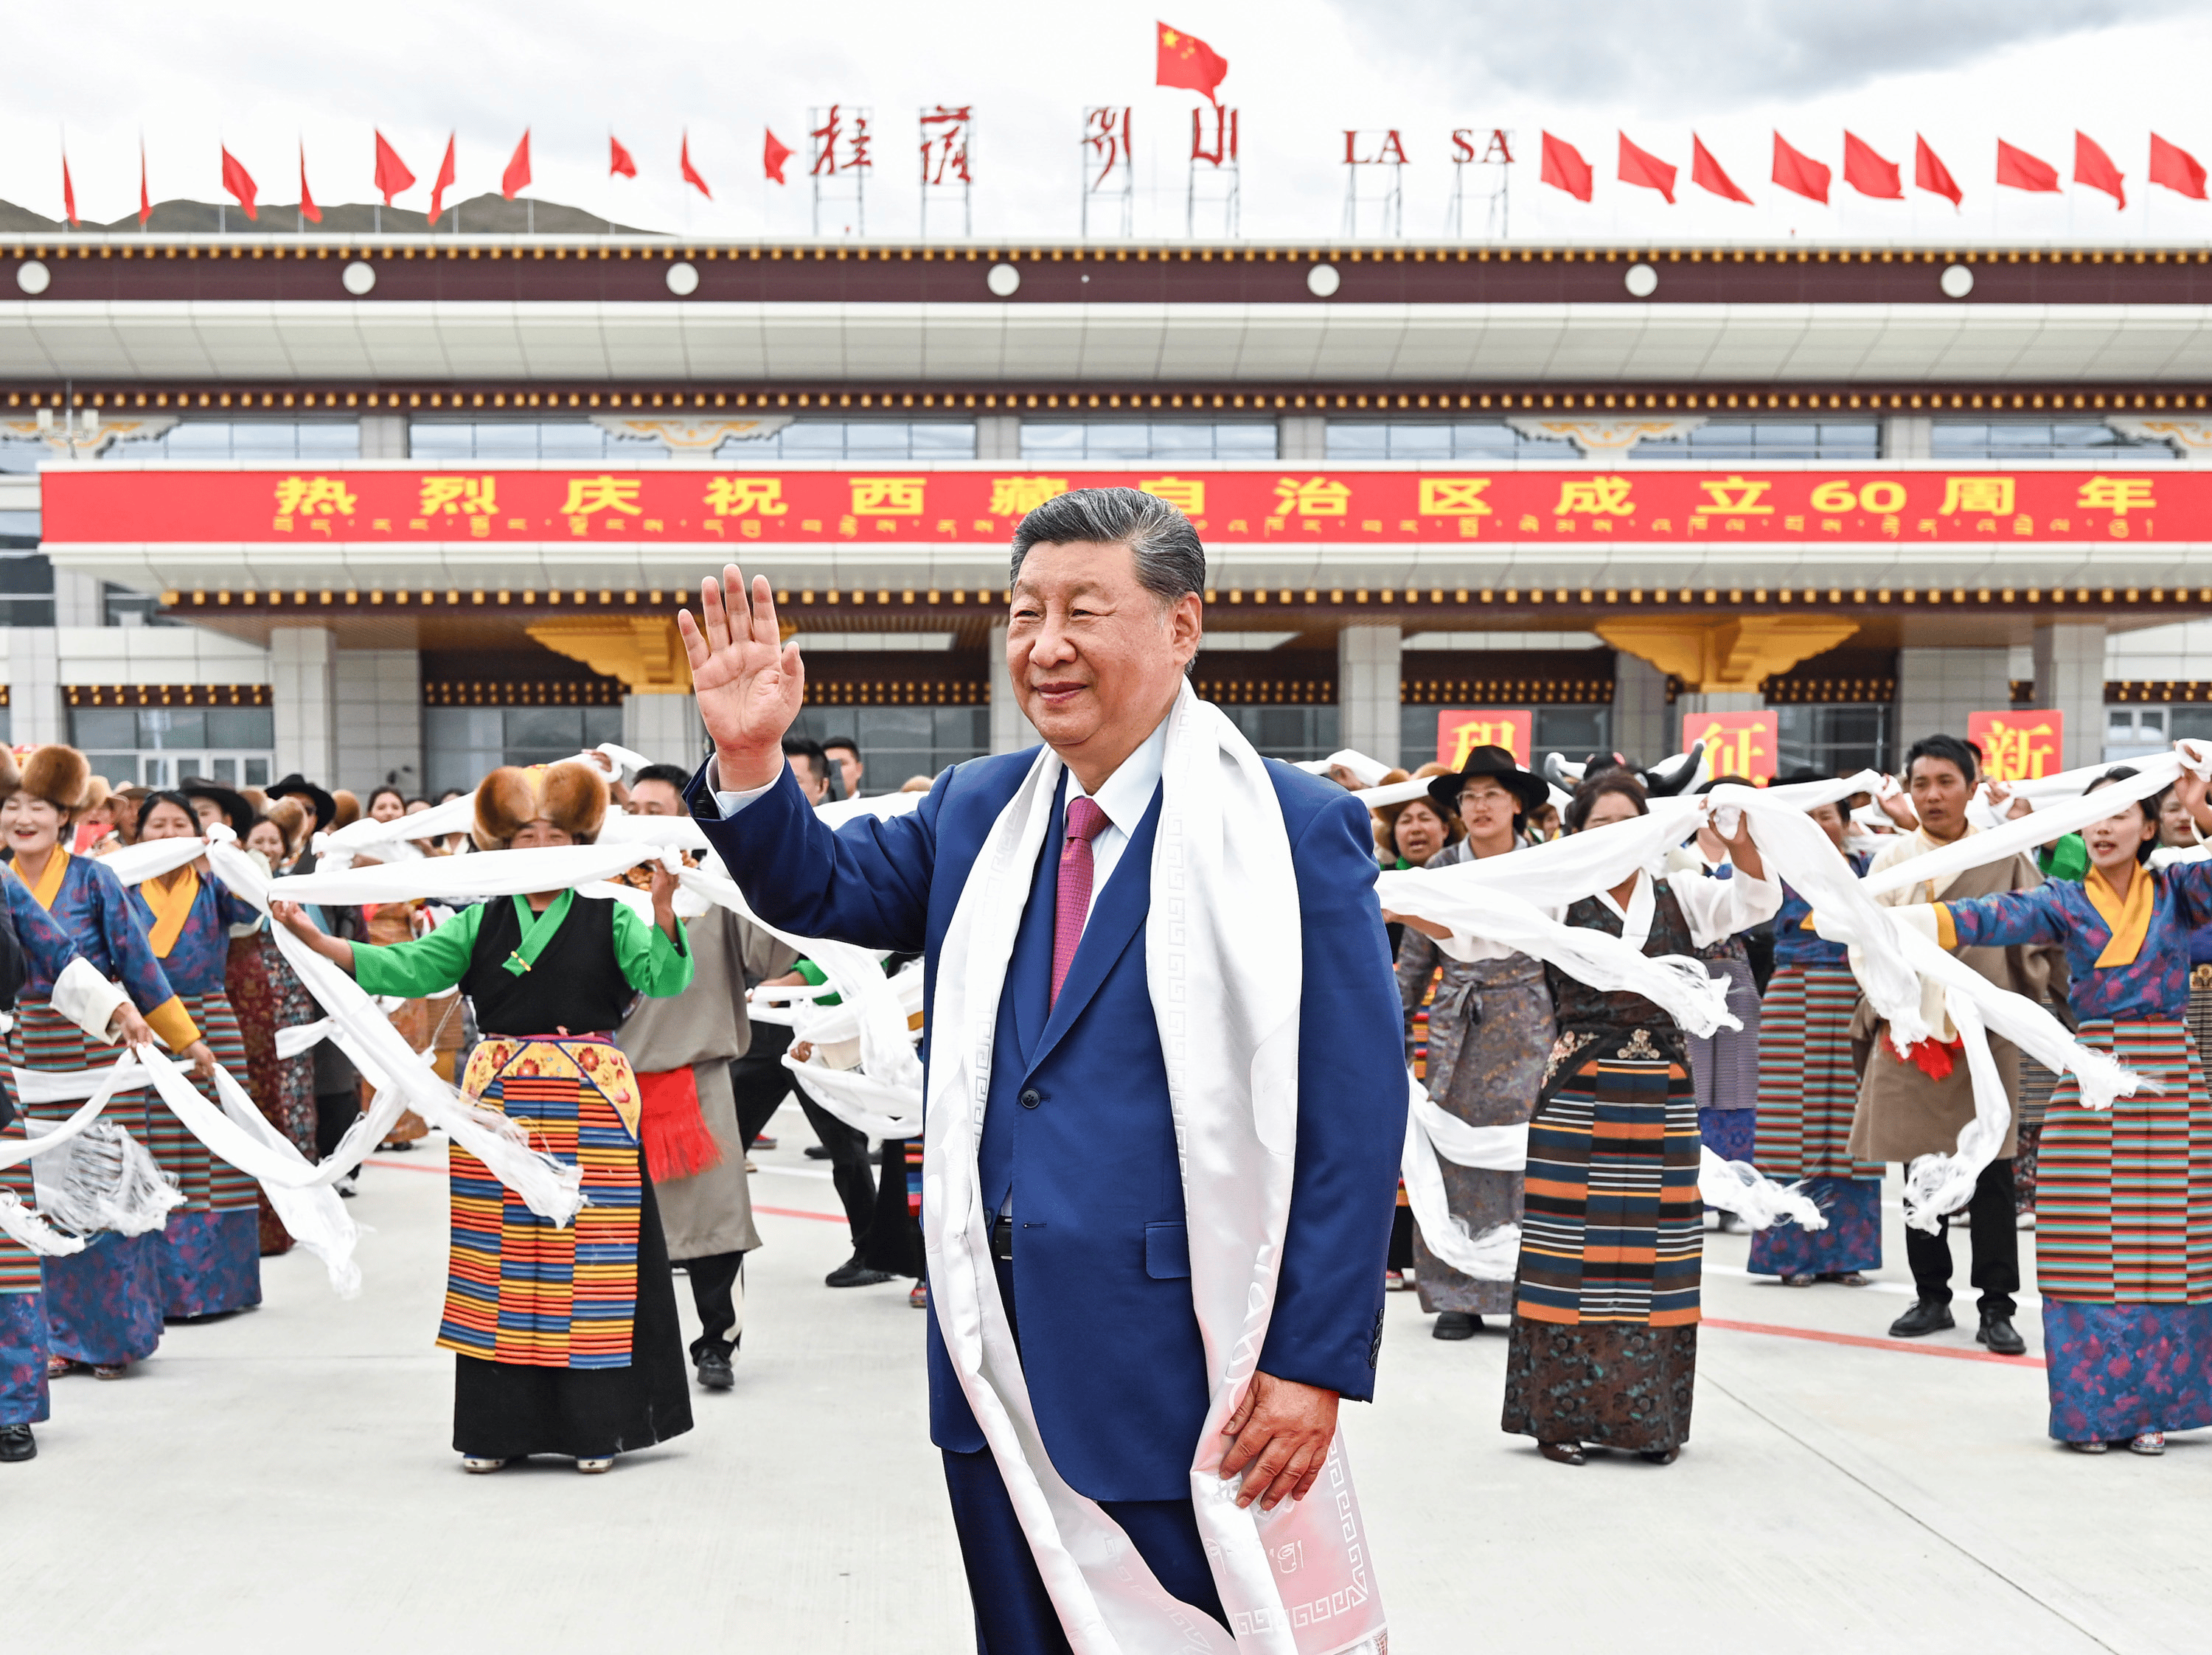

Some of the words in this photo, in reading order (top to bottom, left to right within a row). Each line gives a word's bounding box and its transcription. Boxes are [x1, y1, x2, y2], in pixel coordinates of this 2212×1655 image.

[1342, 129, 1410, 164] LA
[1451, 129, 1515, 164] SA
[1700, 721, 1767, 785] 征
[1980, 720, 2054, 782] 新
